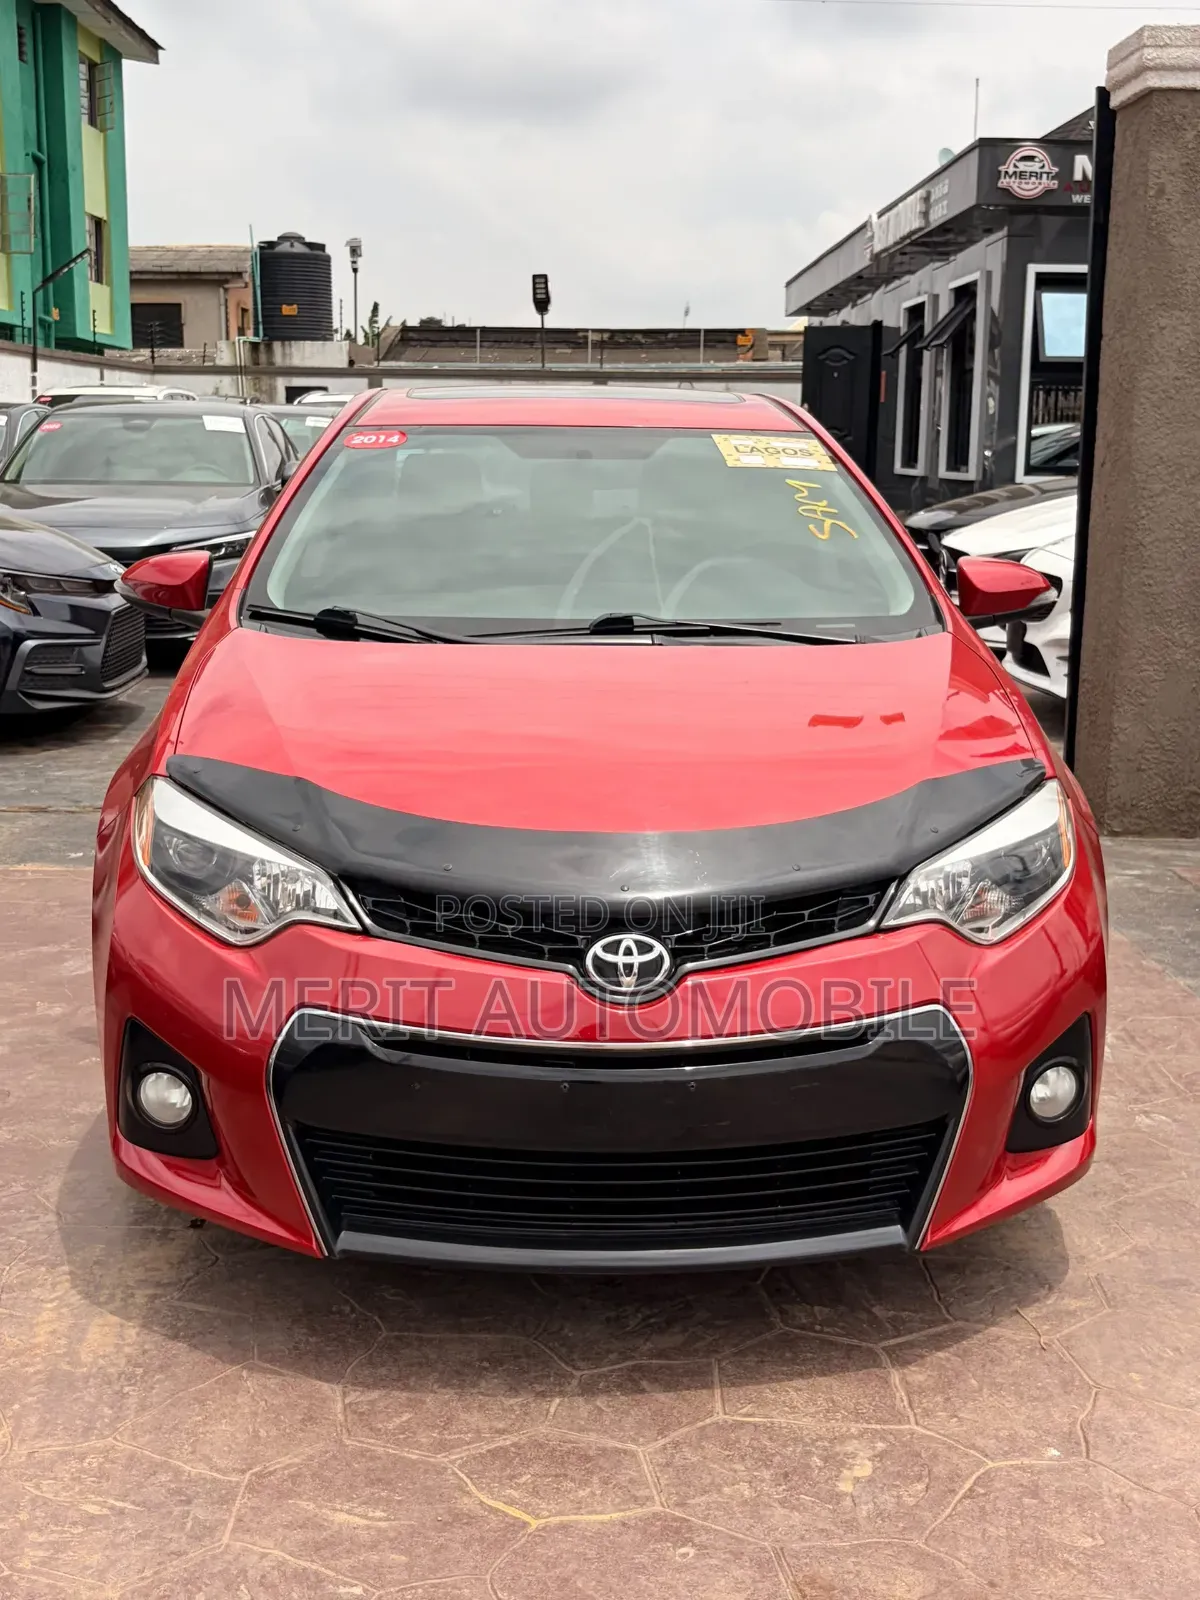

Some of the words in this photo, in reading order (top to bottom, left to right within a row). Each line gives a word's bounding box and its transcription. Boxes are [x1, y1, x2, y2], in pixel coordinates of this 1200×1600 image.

[1003, 170, 1053, 180] MERIT
[1072, 194, 1092, 204] WE
[351, 435, 400, 444] 2014
[733, 445, 815, 457] LAGOS
